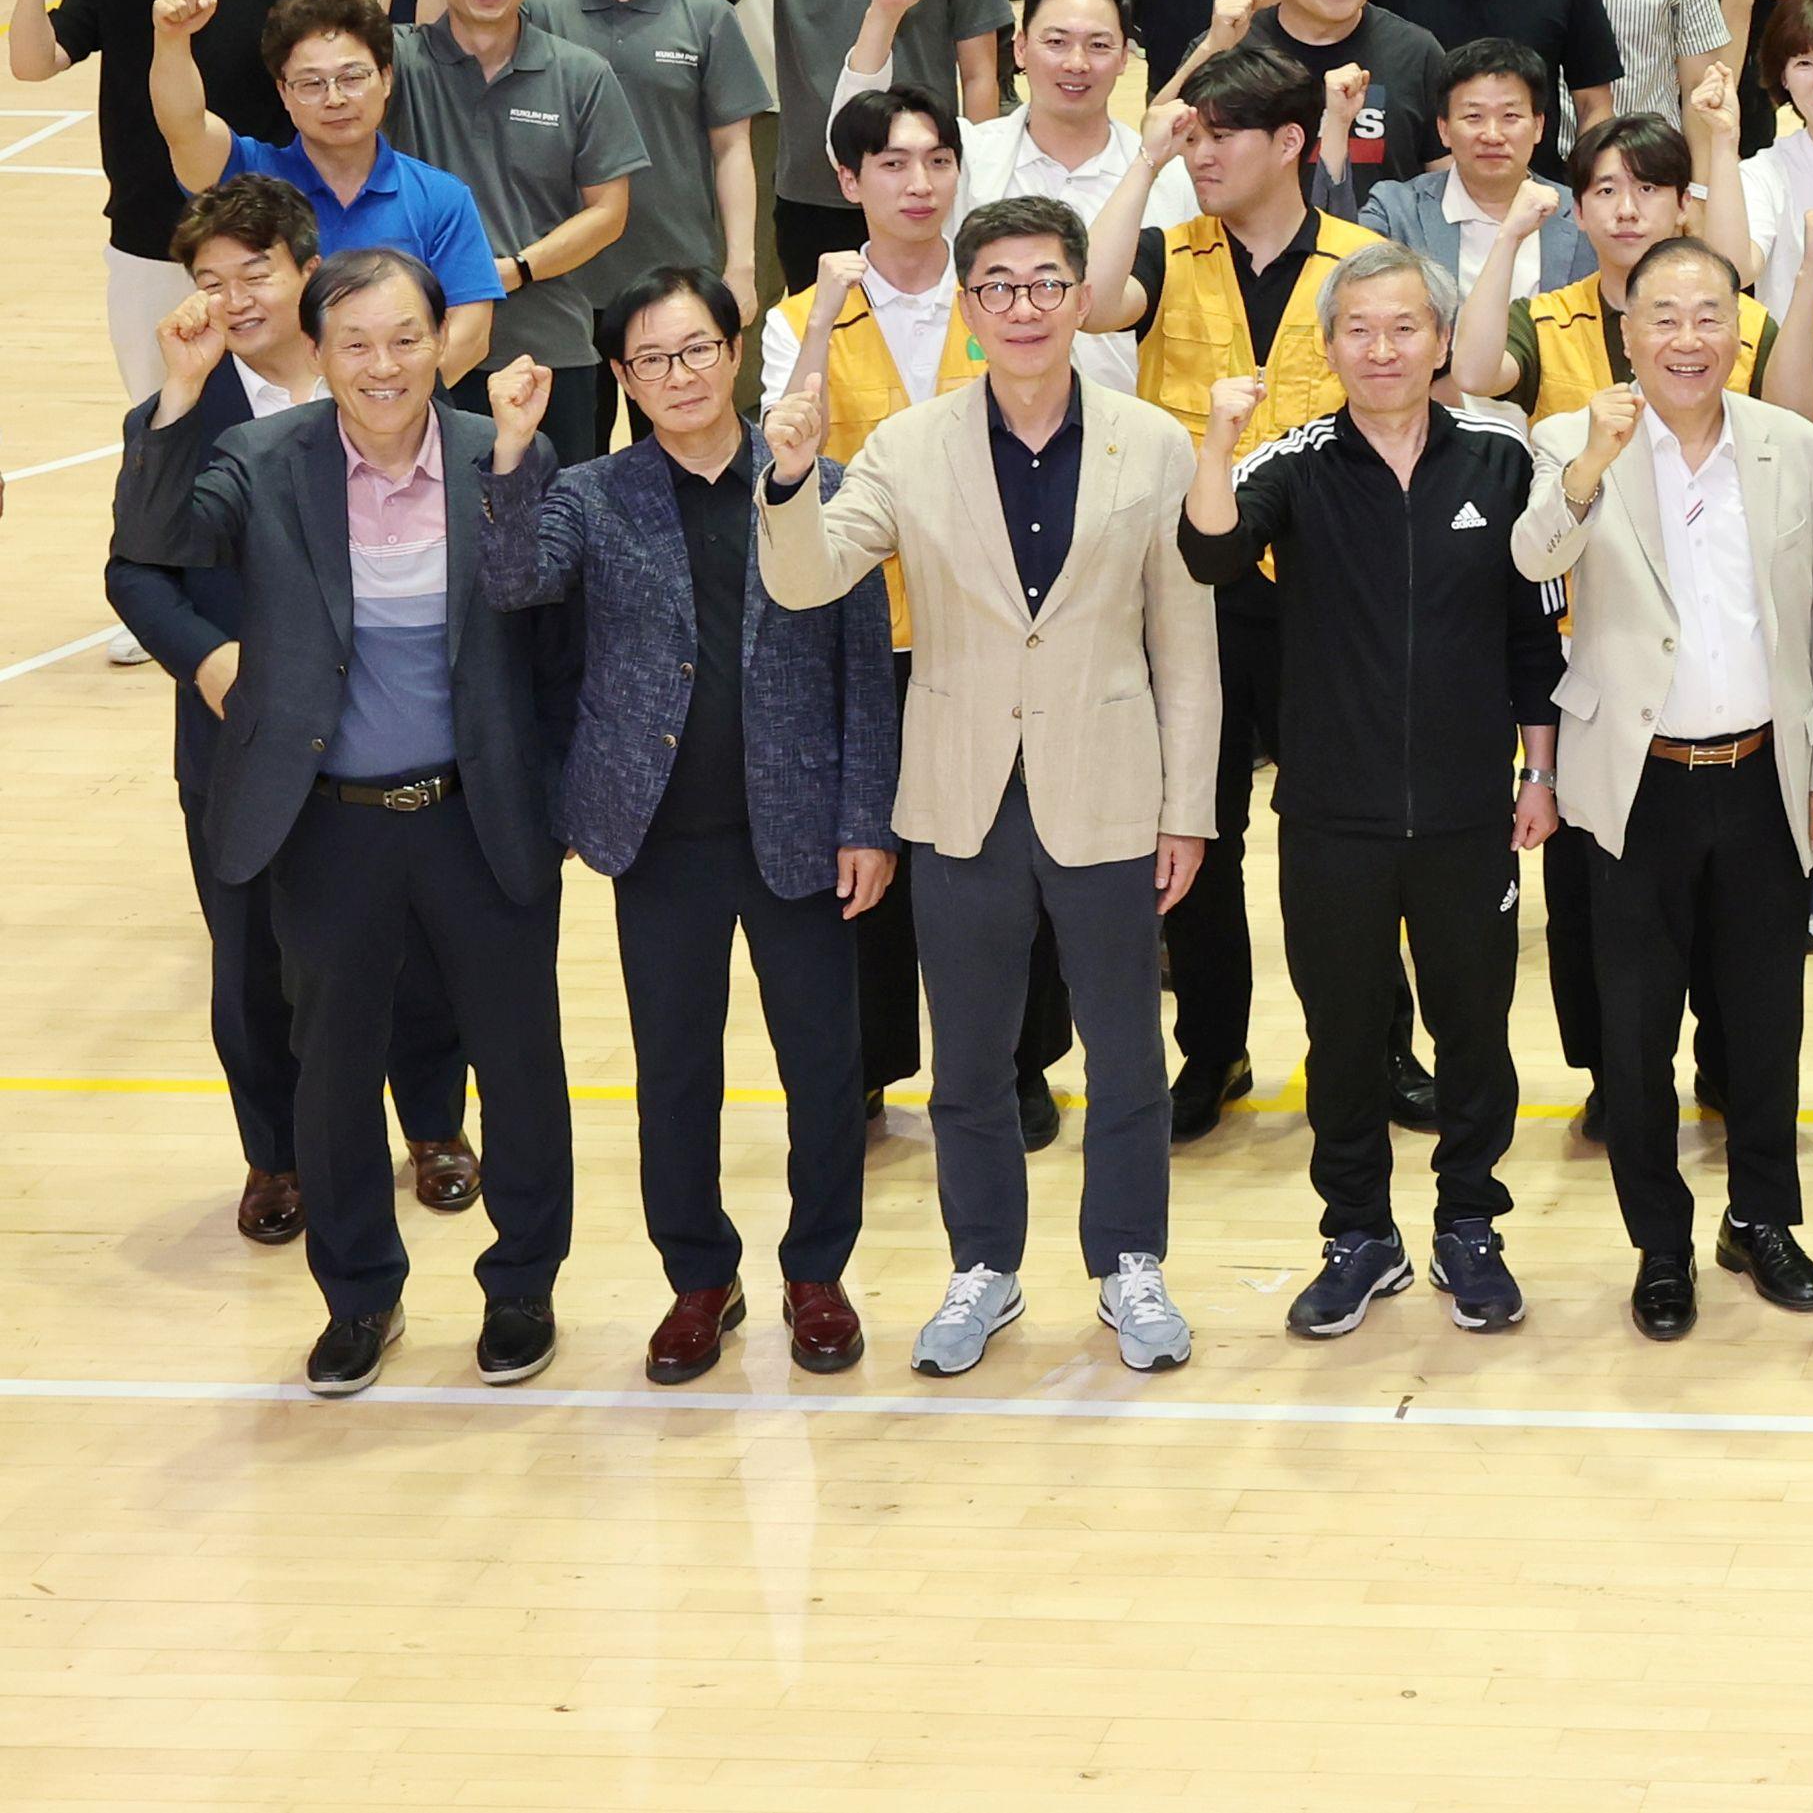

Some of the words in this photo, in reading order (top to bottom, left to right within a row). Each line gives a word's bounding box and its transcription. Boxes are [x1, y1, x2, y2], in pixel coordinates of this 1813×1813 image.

[510, 108, 542, 119] KUKLIM
[542, 112, 560, 122] PNT
[1450, 516, 1488, 530] adidas
